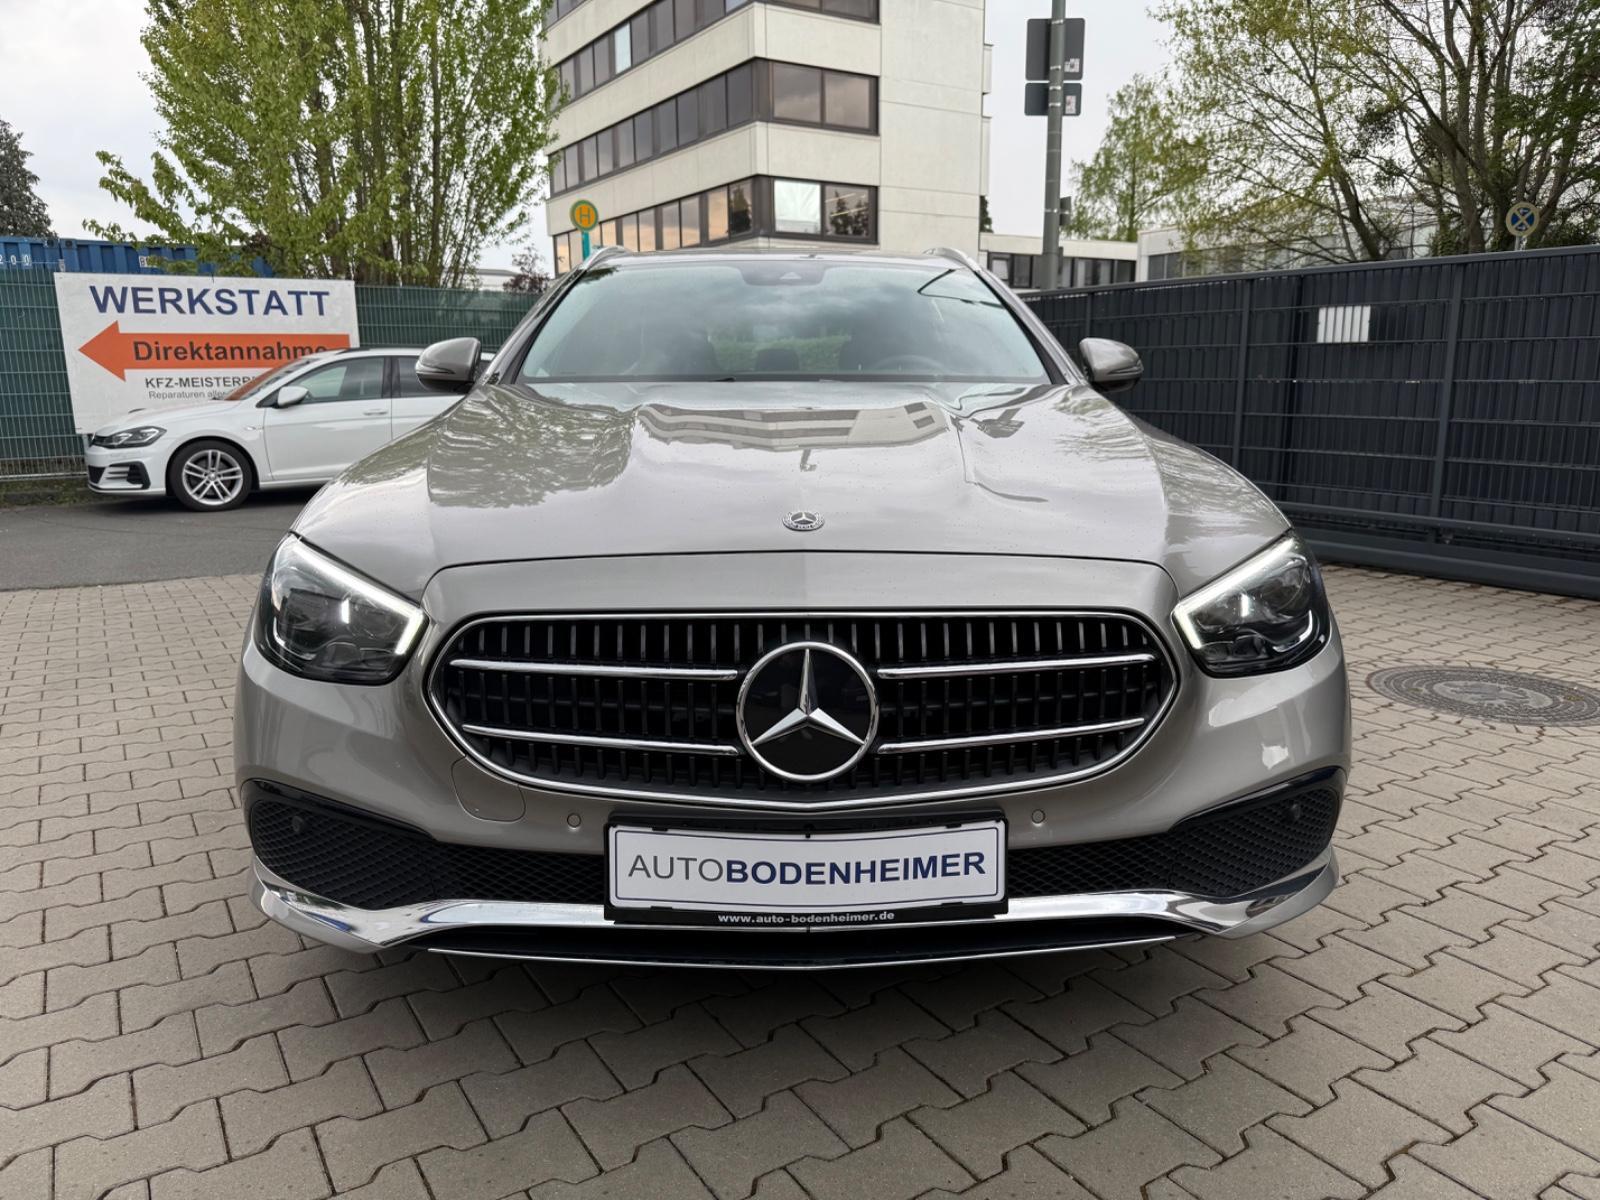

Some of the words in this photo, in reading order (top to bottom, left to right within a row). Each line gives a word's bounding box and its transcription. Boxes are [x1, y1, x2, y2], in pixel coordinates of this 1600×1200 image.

[579, 206, 591, 224] H
[89, 285, 330, 316] WERKSTATT
[149, 390, 205, 401] Reparaturen
[628, 852, 986, 885] AUTOBODENHEIMER
[718, 911, 896, 924] www.auto-bodenheimer.de
